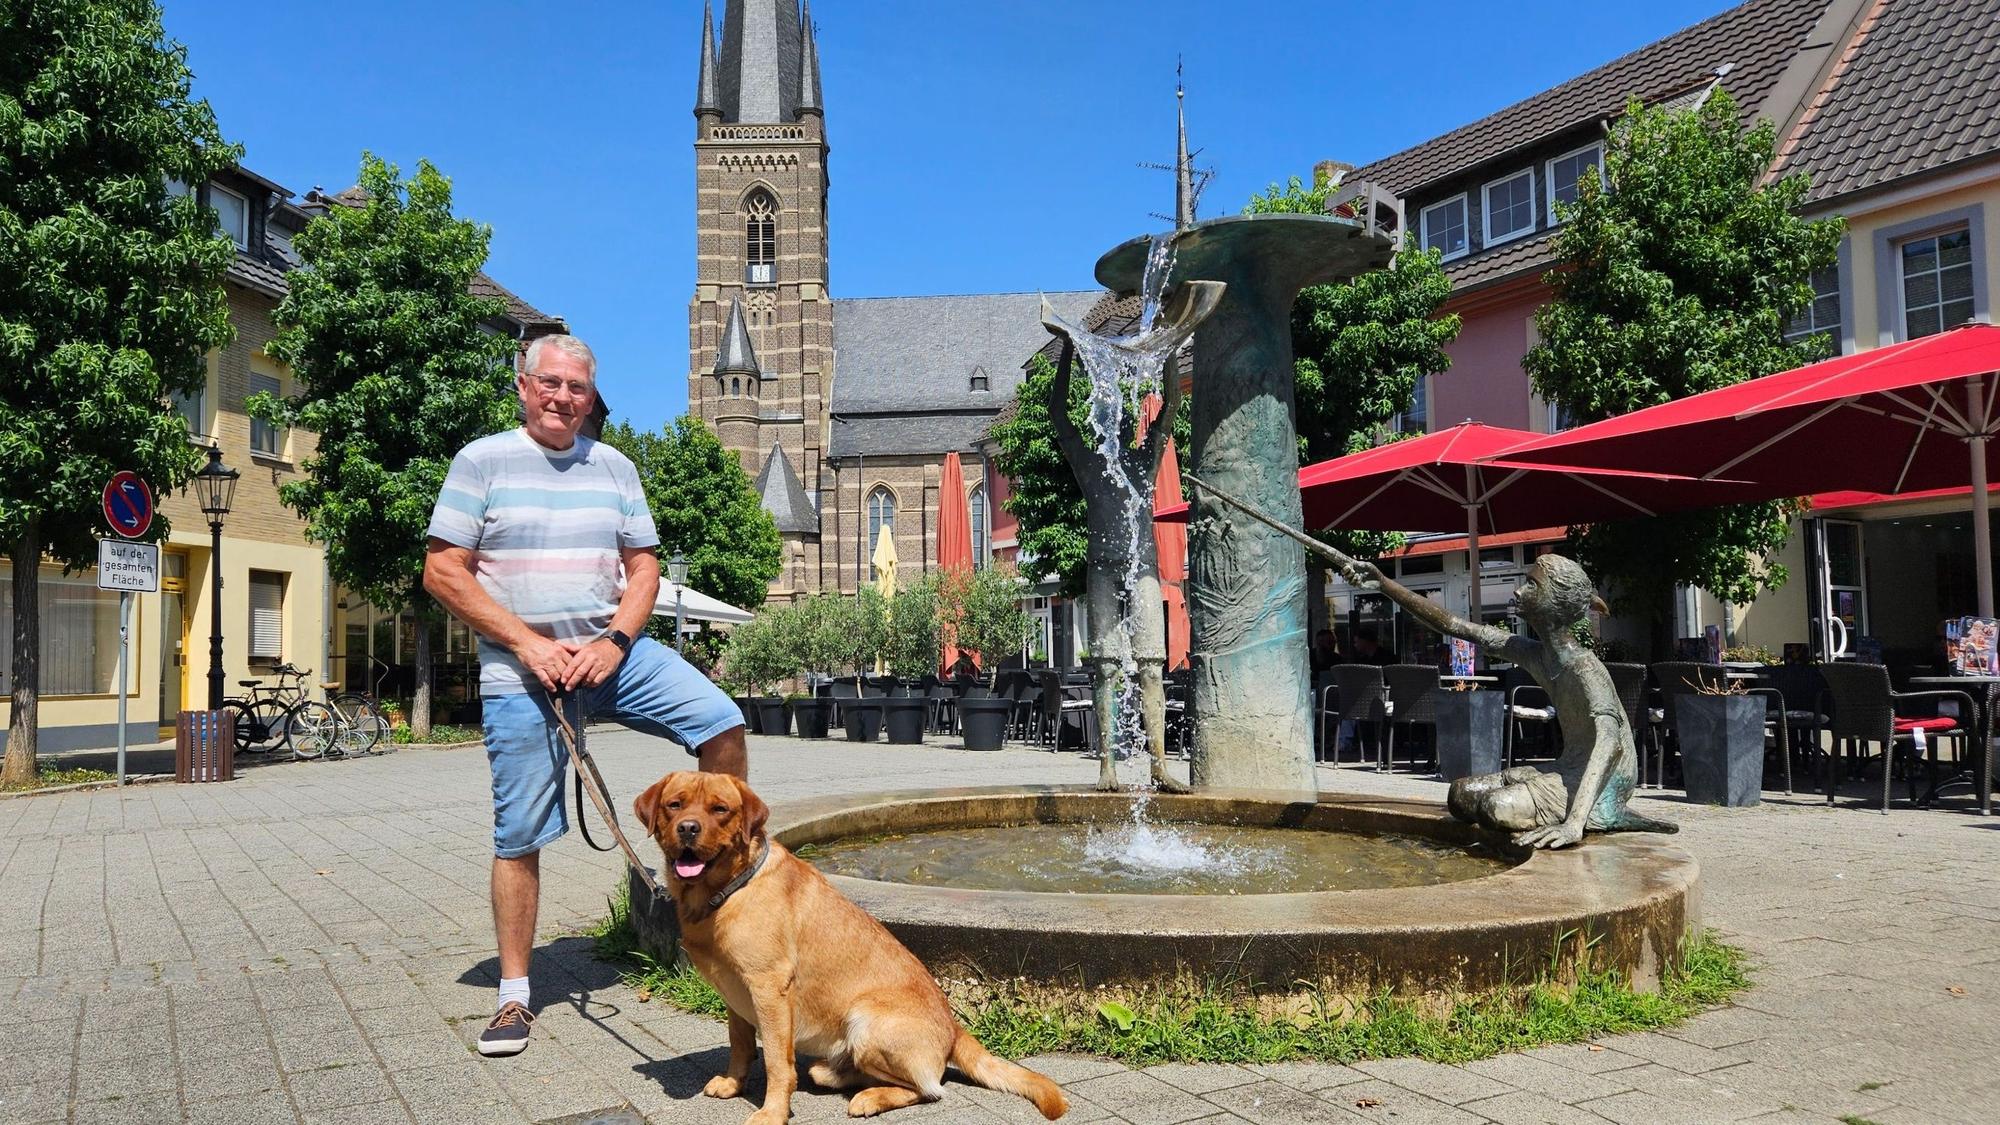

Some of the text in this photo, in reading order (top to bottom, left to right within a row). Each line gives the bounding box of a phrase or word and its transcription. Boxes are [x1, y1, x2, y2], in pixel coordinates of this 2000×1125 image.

[111, 547, 147, 559] auf der
[105, 561, 153, 574] gesamten
[112, 573, 144, 586] Fläche
